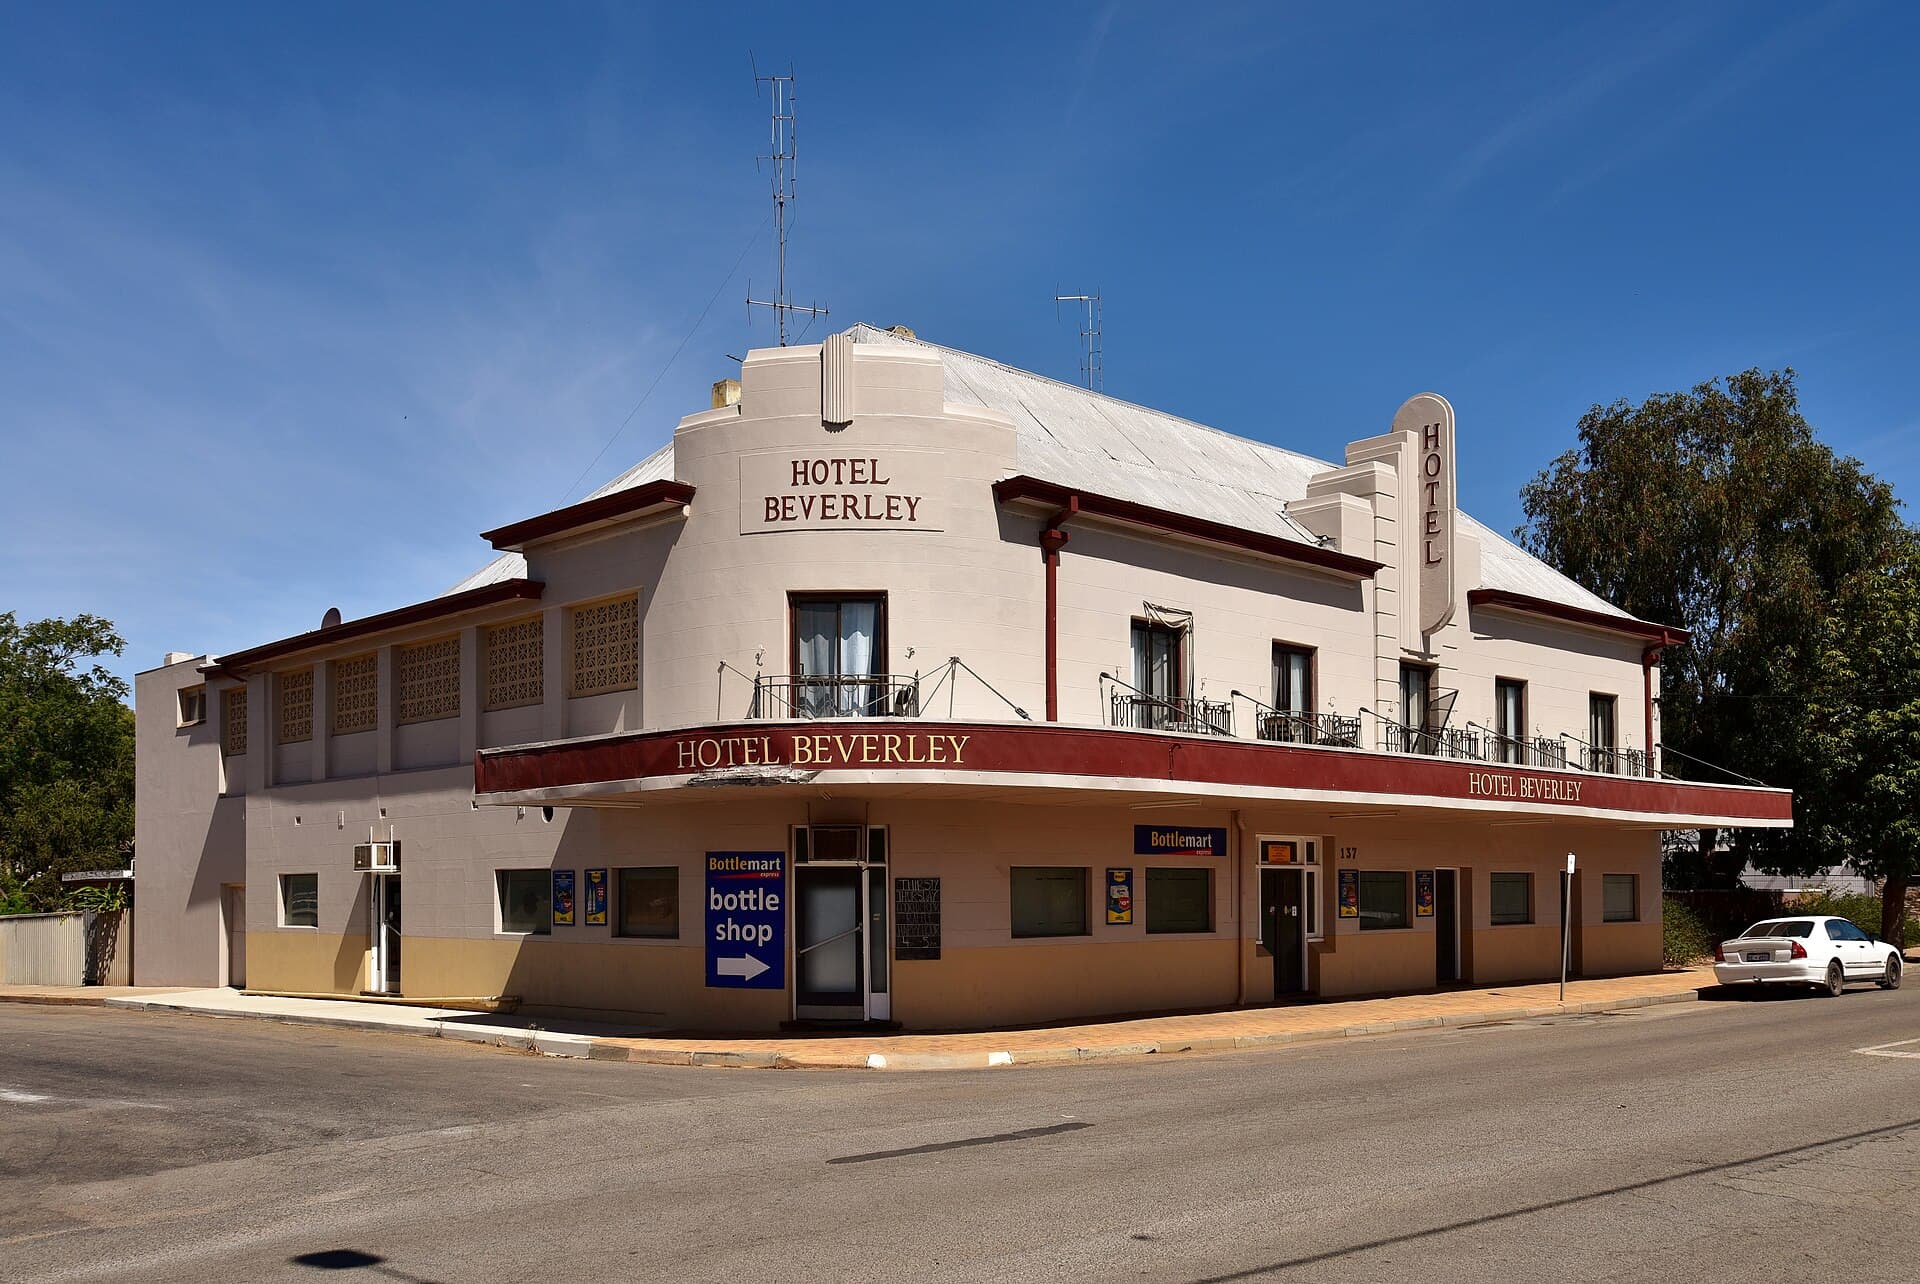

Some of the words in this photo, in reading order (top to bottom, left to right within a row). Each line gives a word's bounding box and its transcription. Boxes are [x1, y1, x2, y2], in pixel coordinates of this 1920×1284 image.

[791, 458, 890, 486] HOTEL
[1423, 423, 1442, 565] HOTEL
[764, 494, 921, 523] BEVERLEY
[677, 736, 780, 769] HOTEL
[791, 734, 971, 765] BEVERLEY
[1469, 772, 1517, 797] HOTEL
[1520, 776, 1582, 801] BEVERLEY
[1151, 830, 1213, 849] Bottlemart
[1340, 847, 1358, 860] 137
[709, 856, 781, 871] Bottlemart
[710, 887, 780, 911] bottle
[716, 917, 773, 947] shop
